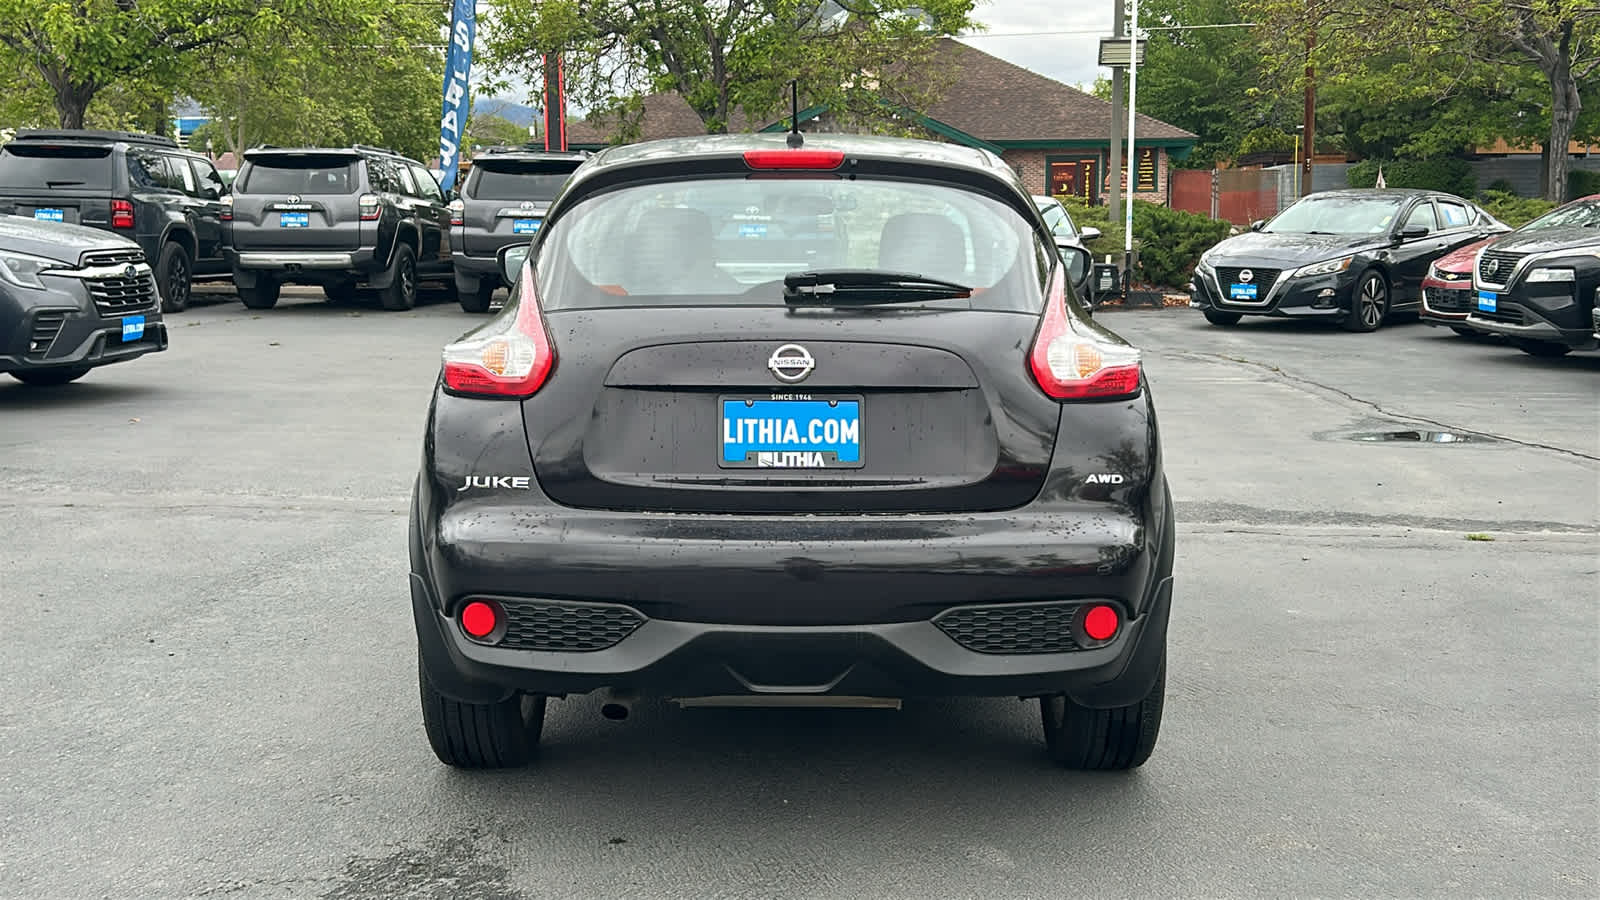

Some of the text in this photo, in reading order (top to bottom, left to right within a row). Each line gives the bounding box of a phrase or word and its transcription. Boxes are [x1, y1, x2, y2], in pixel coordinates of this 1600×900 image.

[773, 358, 810, 366] NISSAN
[723, 418, 859, 444] LITHIA.COM
[773, 452, 825, 467] LITHIA
[457, 476, 530, 492] JUKE
[1085, 474, 1124, 484] AWD
